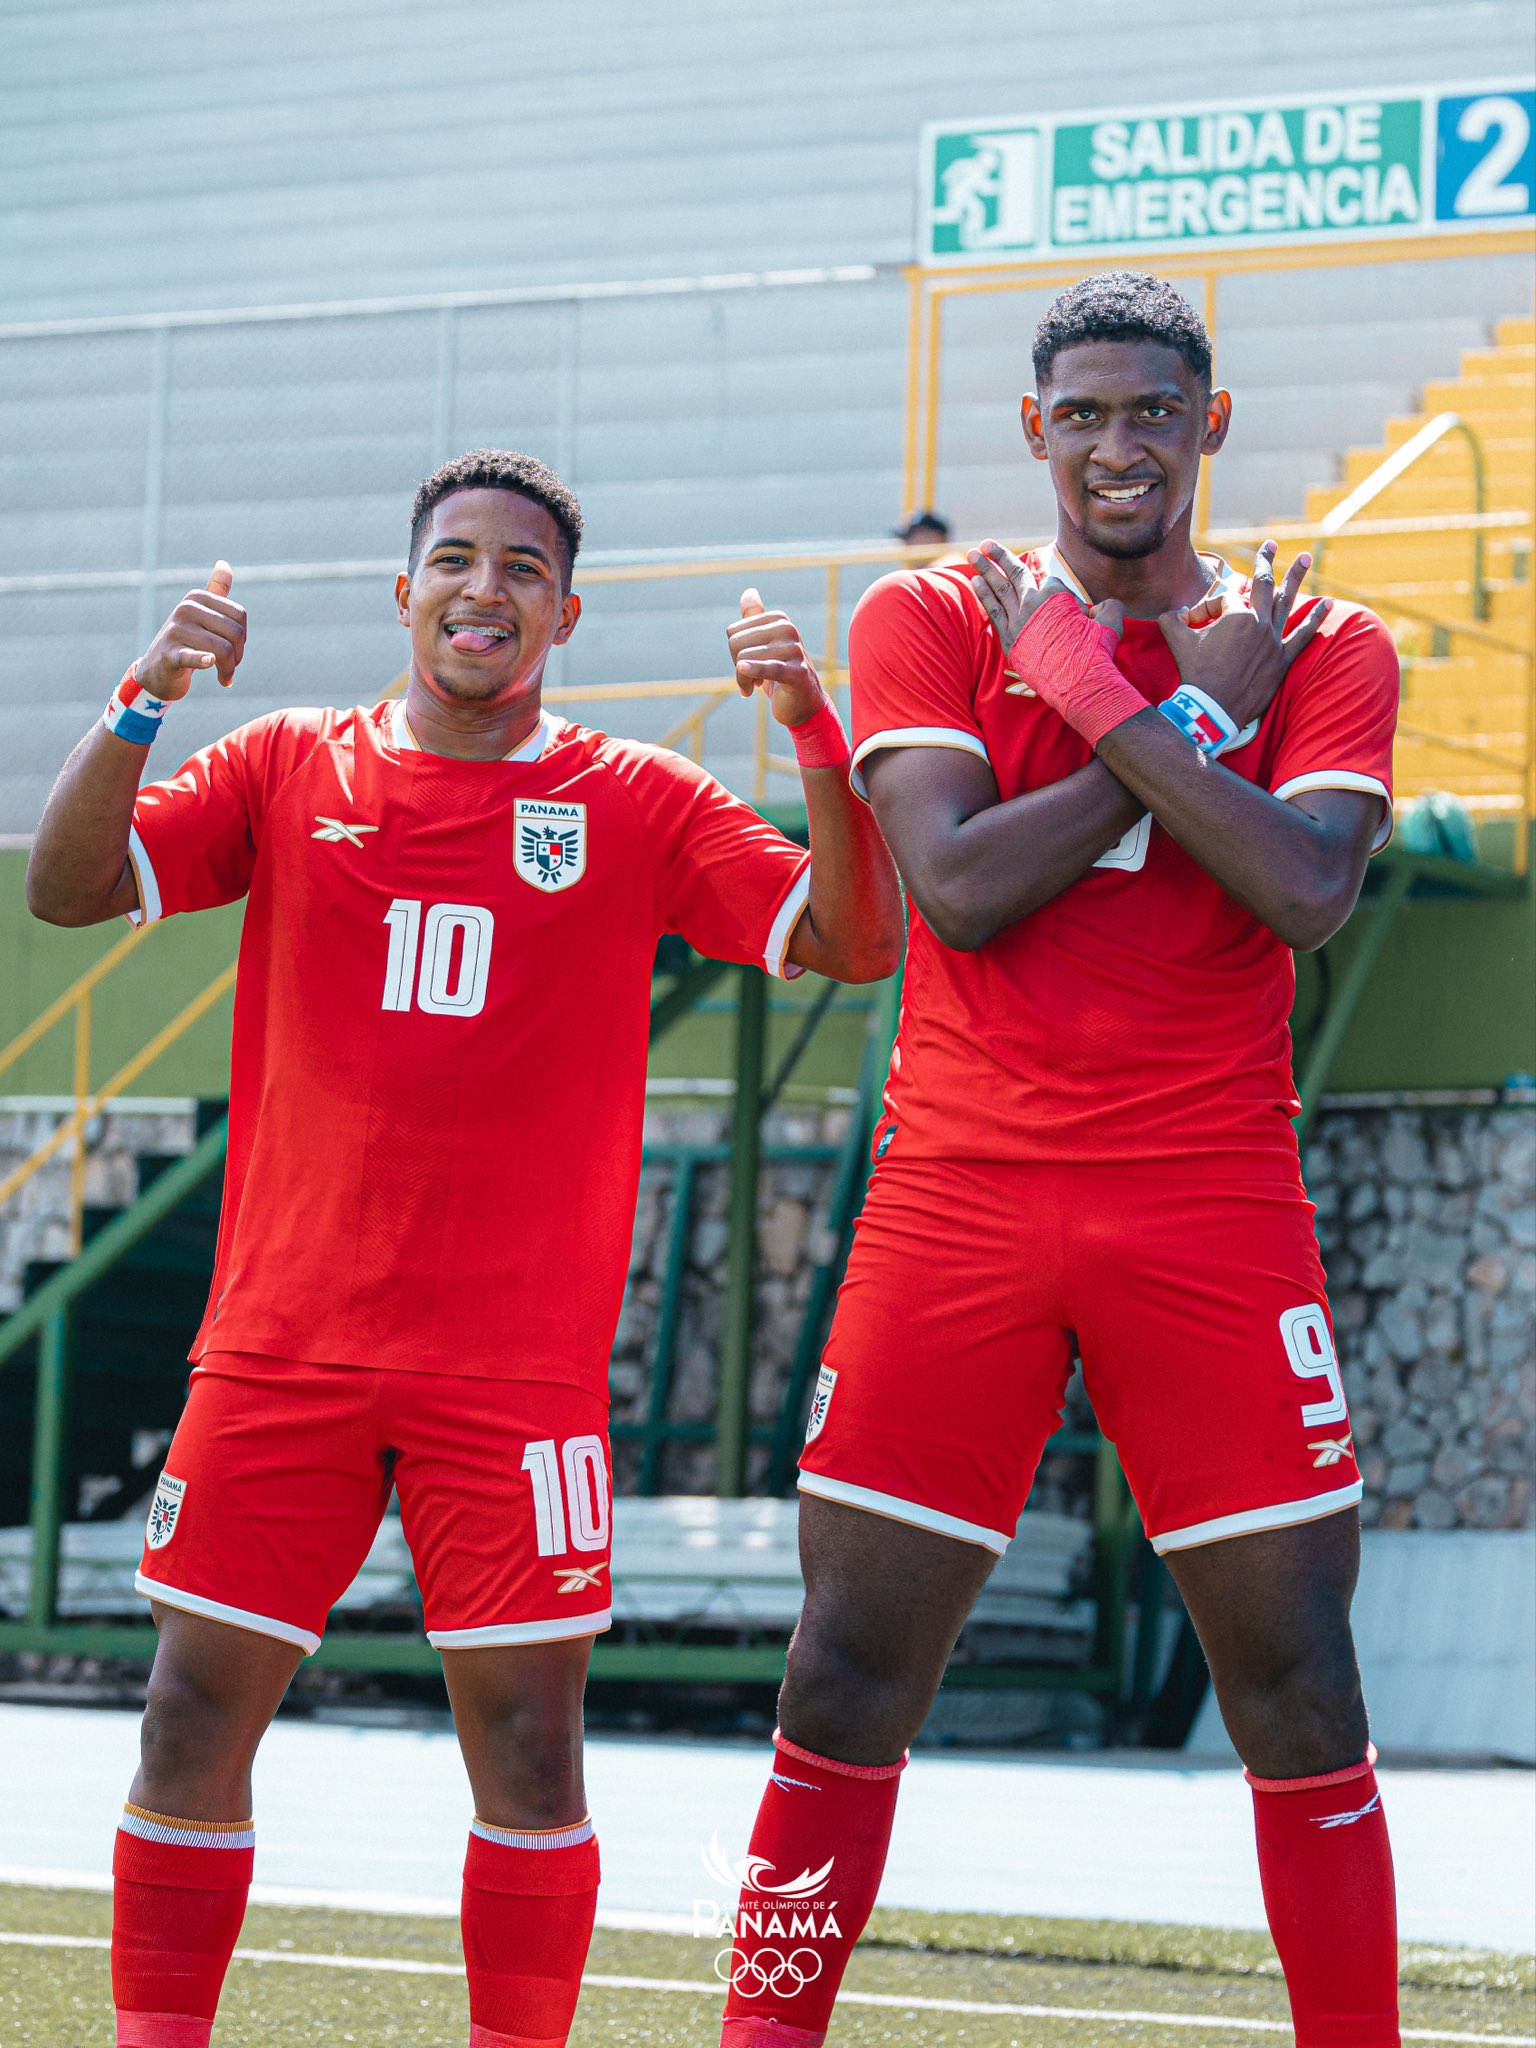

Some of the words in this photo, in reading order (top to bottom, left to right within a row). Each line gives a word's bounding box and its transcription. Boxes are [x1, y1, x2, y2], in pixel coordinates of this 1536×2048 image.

[1089, 110, 1296, 179] SALIDA
[1303, 102, 1385, 164] DE
[1453, 96, 1531, 217] 2
[1052, 163, 1422, 246] EMERGENCIA
[521, 803, 579, 818] PANAMÁ
[381, 898, 495, 1018] 10
[1279, 1302, 1347, 1428] 9
[521, 1434, 610, 1557] 10
